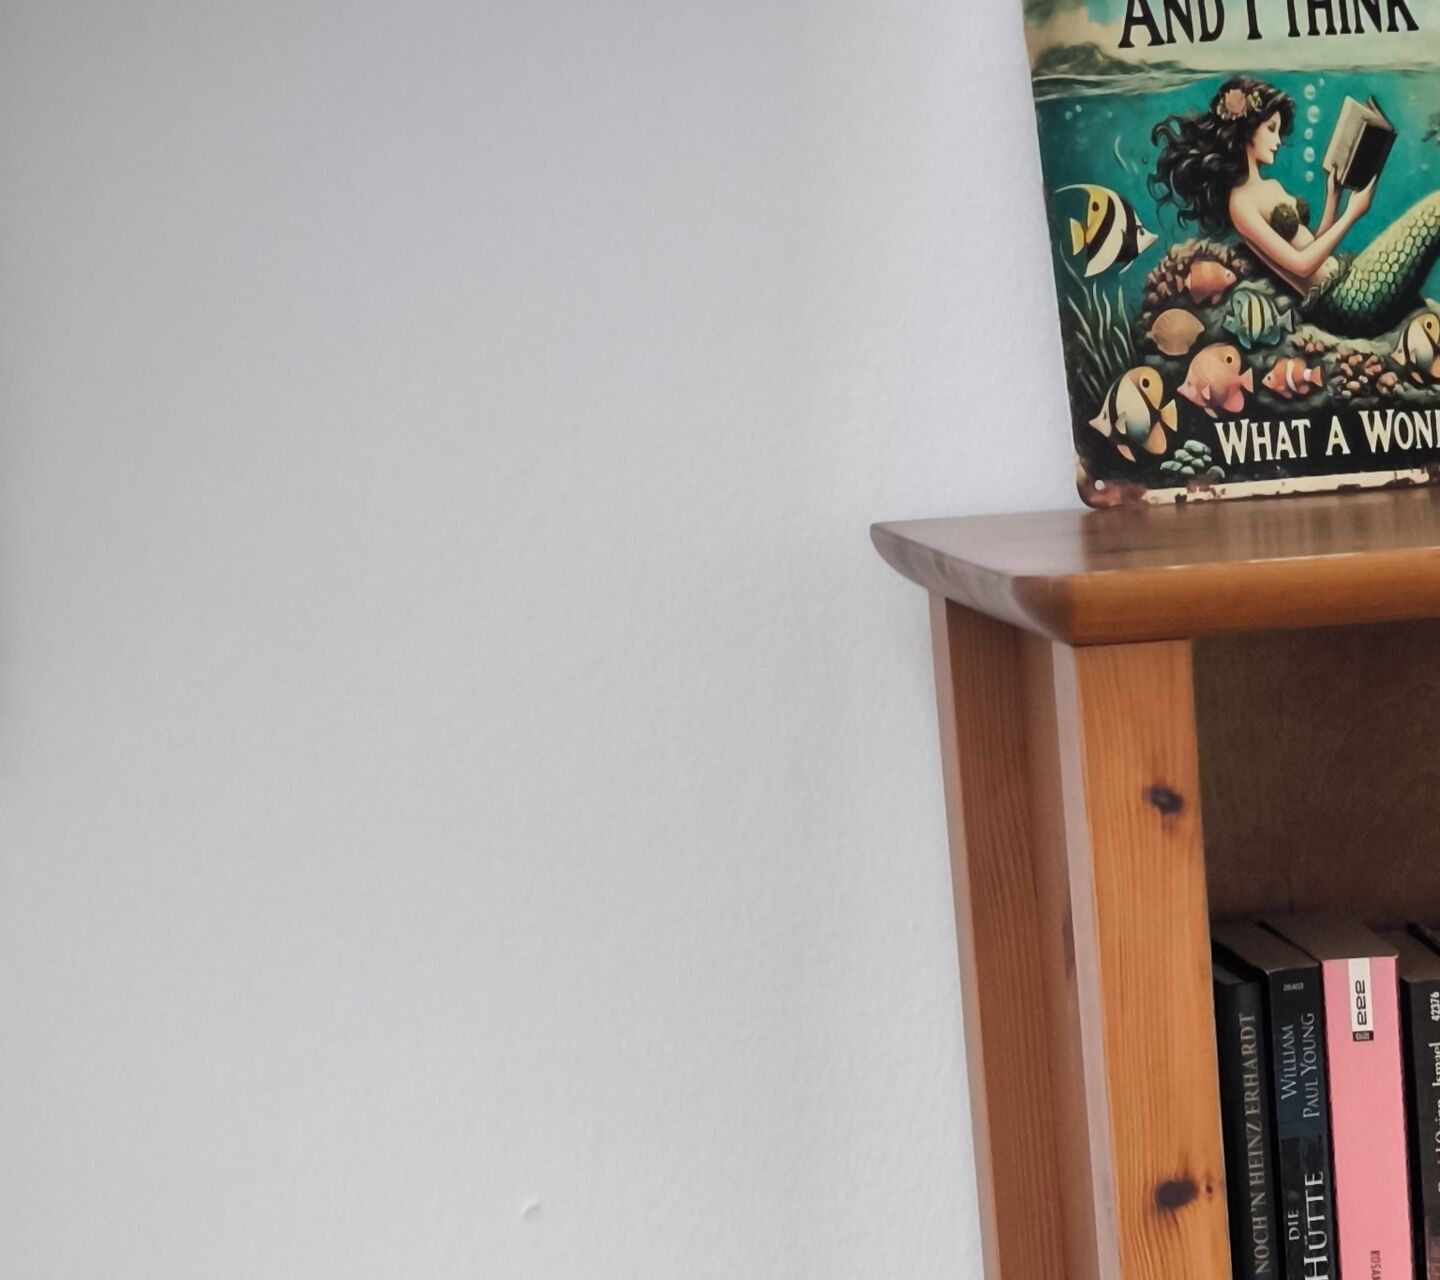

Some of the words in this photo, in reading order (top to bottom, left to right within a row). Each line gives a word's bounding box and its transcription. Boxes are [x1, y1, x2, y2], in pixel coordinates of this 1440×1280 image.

[1118, 0, 1225, 48] AND
[1246, 0, 1262, 39] I
[1288, 0, 1419, 37] THINK
[1214, 418, 1311, 465] WHAT
[1325, 415, 1351, 456] A
[1238, 1013, 1261, 1116] ERHARDT
[1281, 1025, 1297, 1100] WILLIAM
[1301, 1013, 1318, 1077] YOUNG
[1303, 1078, 1320, 1118] PAUL
[1246, 1121, 1266, 1187] HEINZ
[1287, 1208, 1300, 1241] DIE
